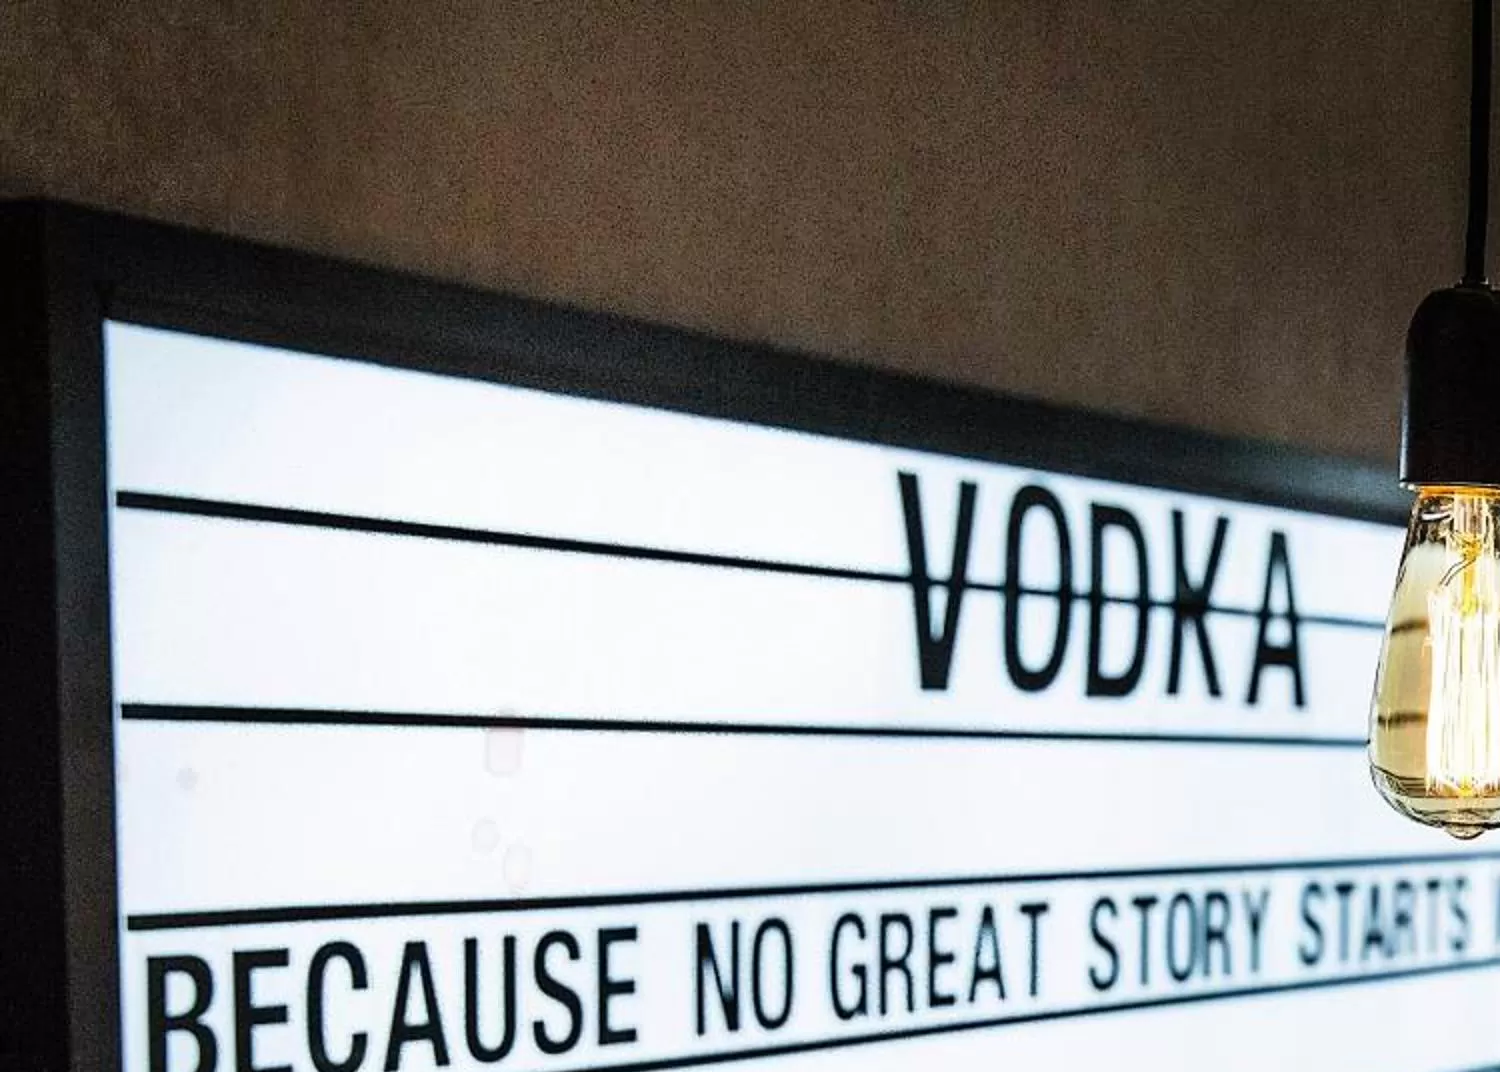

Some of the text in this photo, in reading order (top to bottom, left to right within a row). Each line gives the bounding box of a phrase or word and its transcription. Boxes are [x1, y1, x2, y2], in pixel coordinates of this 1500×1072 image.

[897, 471, 1308, 708] VODKA
[695, 916, 795, 1038] NO
[829, 902, 1050, 1020] GREAT
[1087, 888, 1270, 992] STORY
[1298, 874, 1473, 967] STARTS
